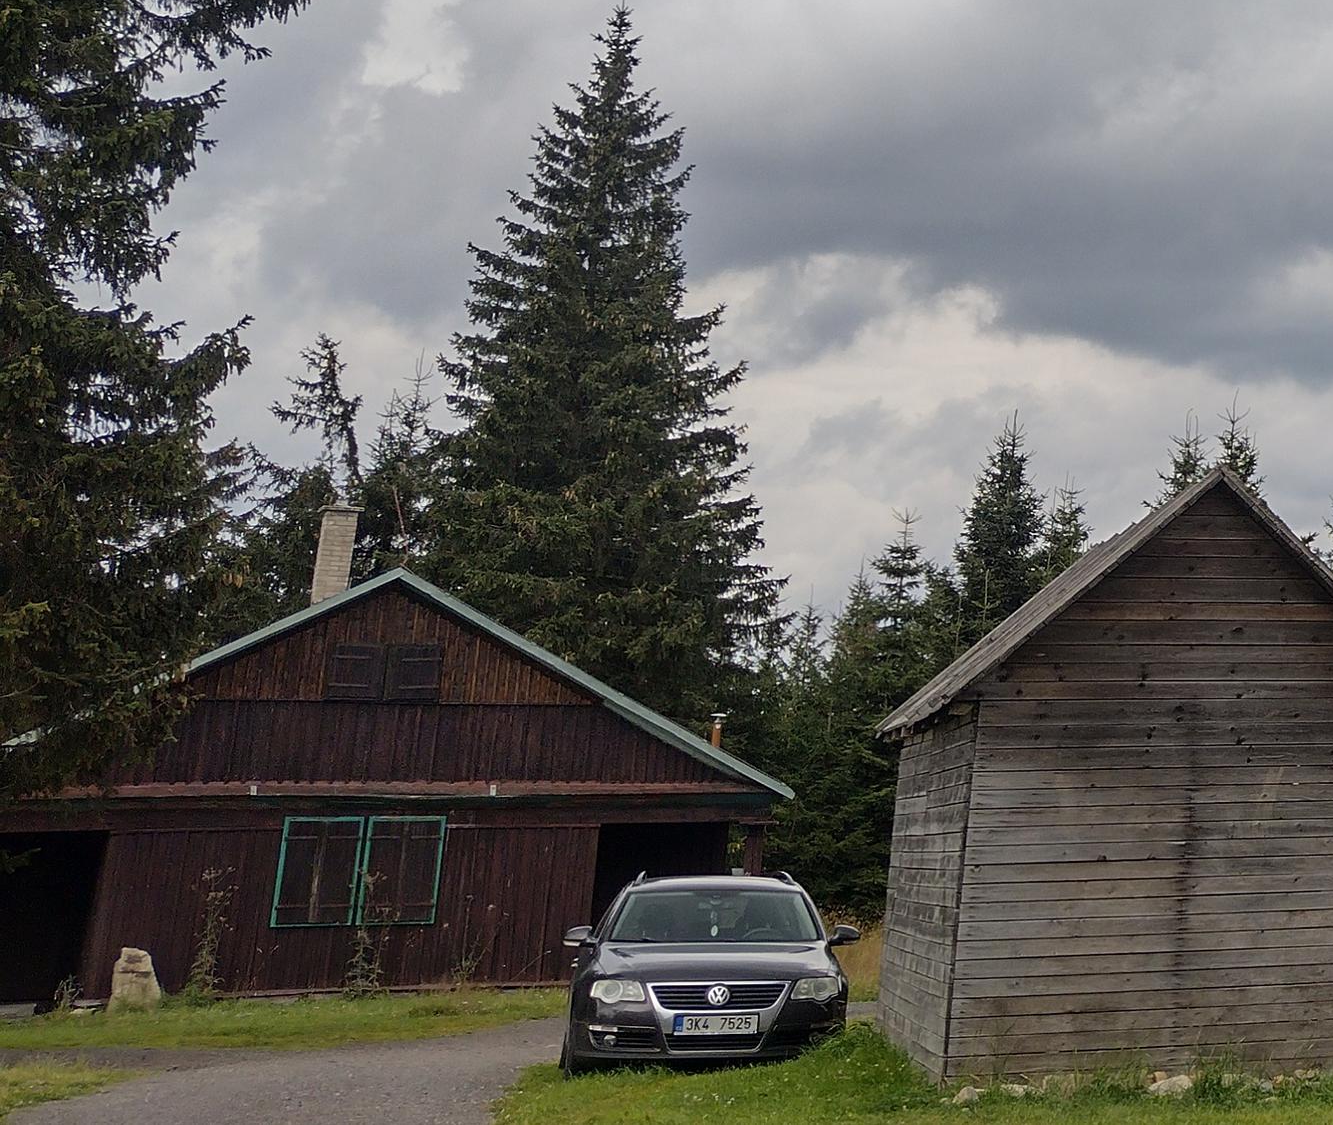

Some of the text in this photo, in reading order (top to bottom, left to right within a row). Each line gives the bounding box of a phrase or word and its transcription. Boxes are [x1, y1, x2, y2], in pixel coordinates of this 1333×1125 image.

[708, 985, 730, 1006] VW
[686, 1018, 710, 1031] 3K4
[720, 1017, 752, 1030] 7525
